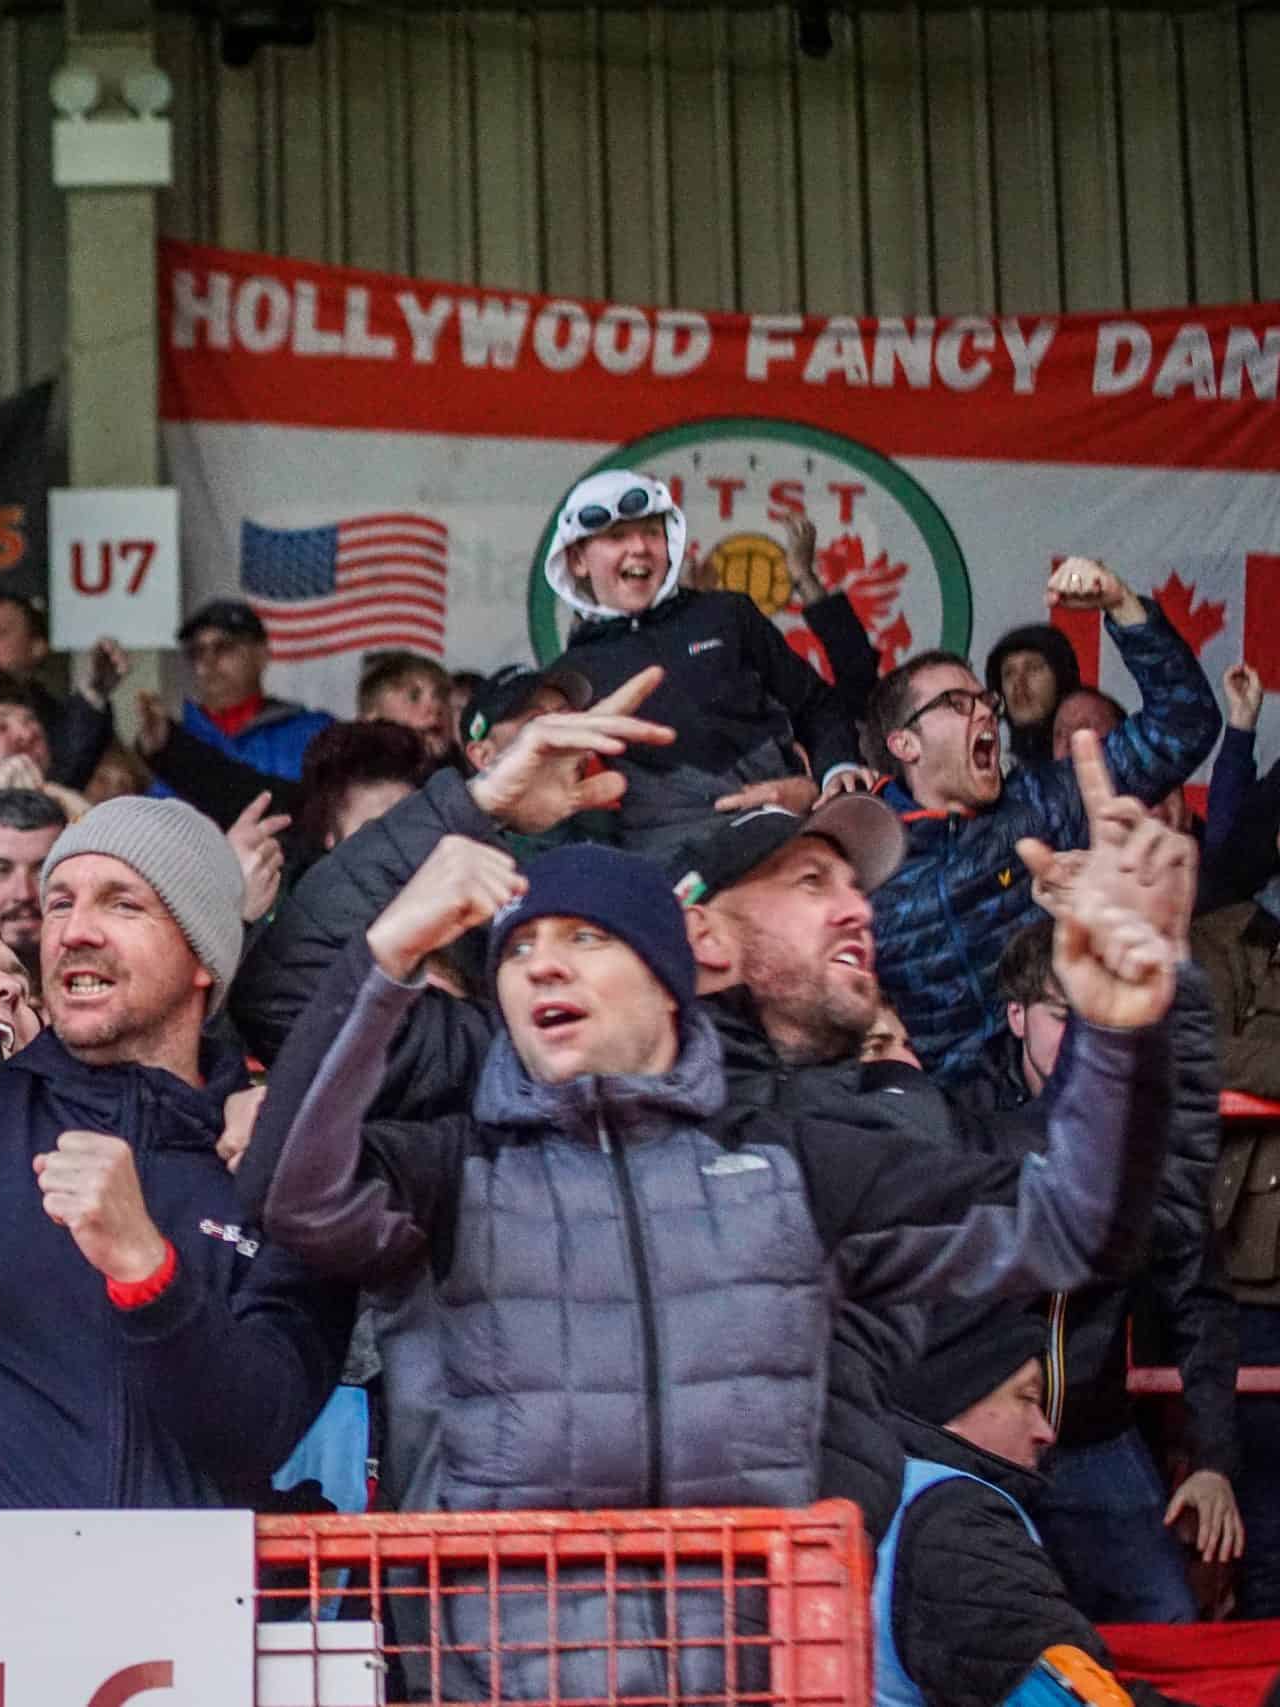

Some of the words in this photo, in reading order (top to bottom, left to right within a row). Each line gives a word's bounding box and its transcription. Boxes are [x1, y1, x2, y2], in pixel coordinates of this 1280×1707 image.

[170, 270, 711, 377] HOLLYWOOD
[745, 313, 1058, 395] FANCY
[1091, 320, 1280, 400] DAN
[70, 539, 157, 596] U7
